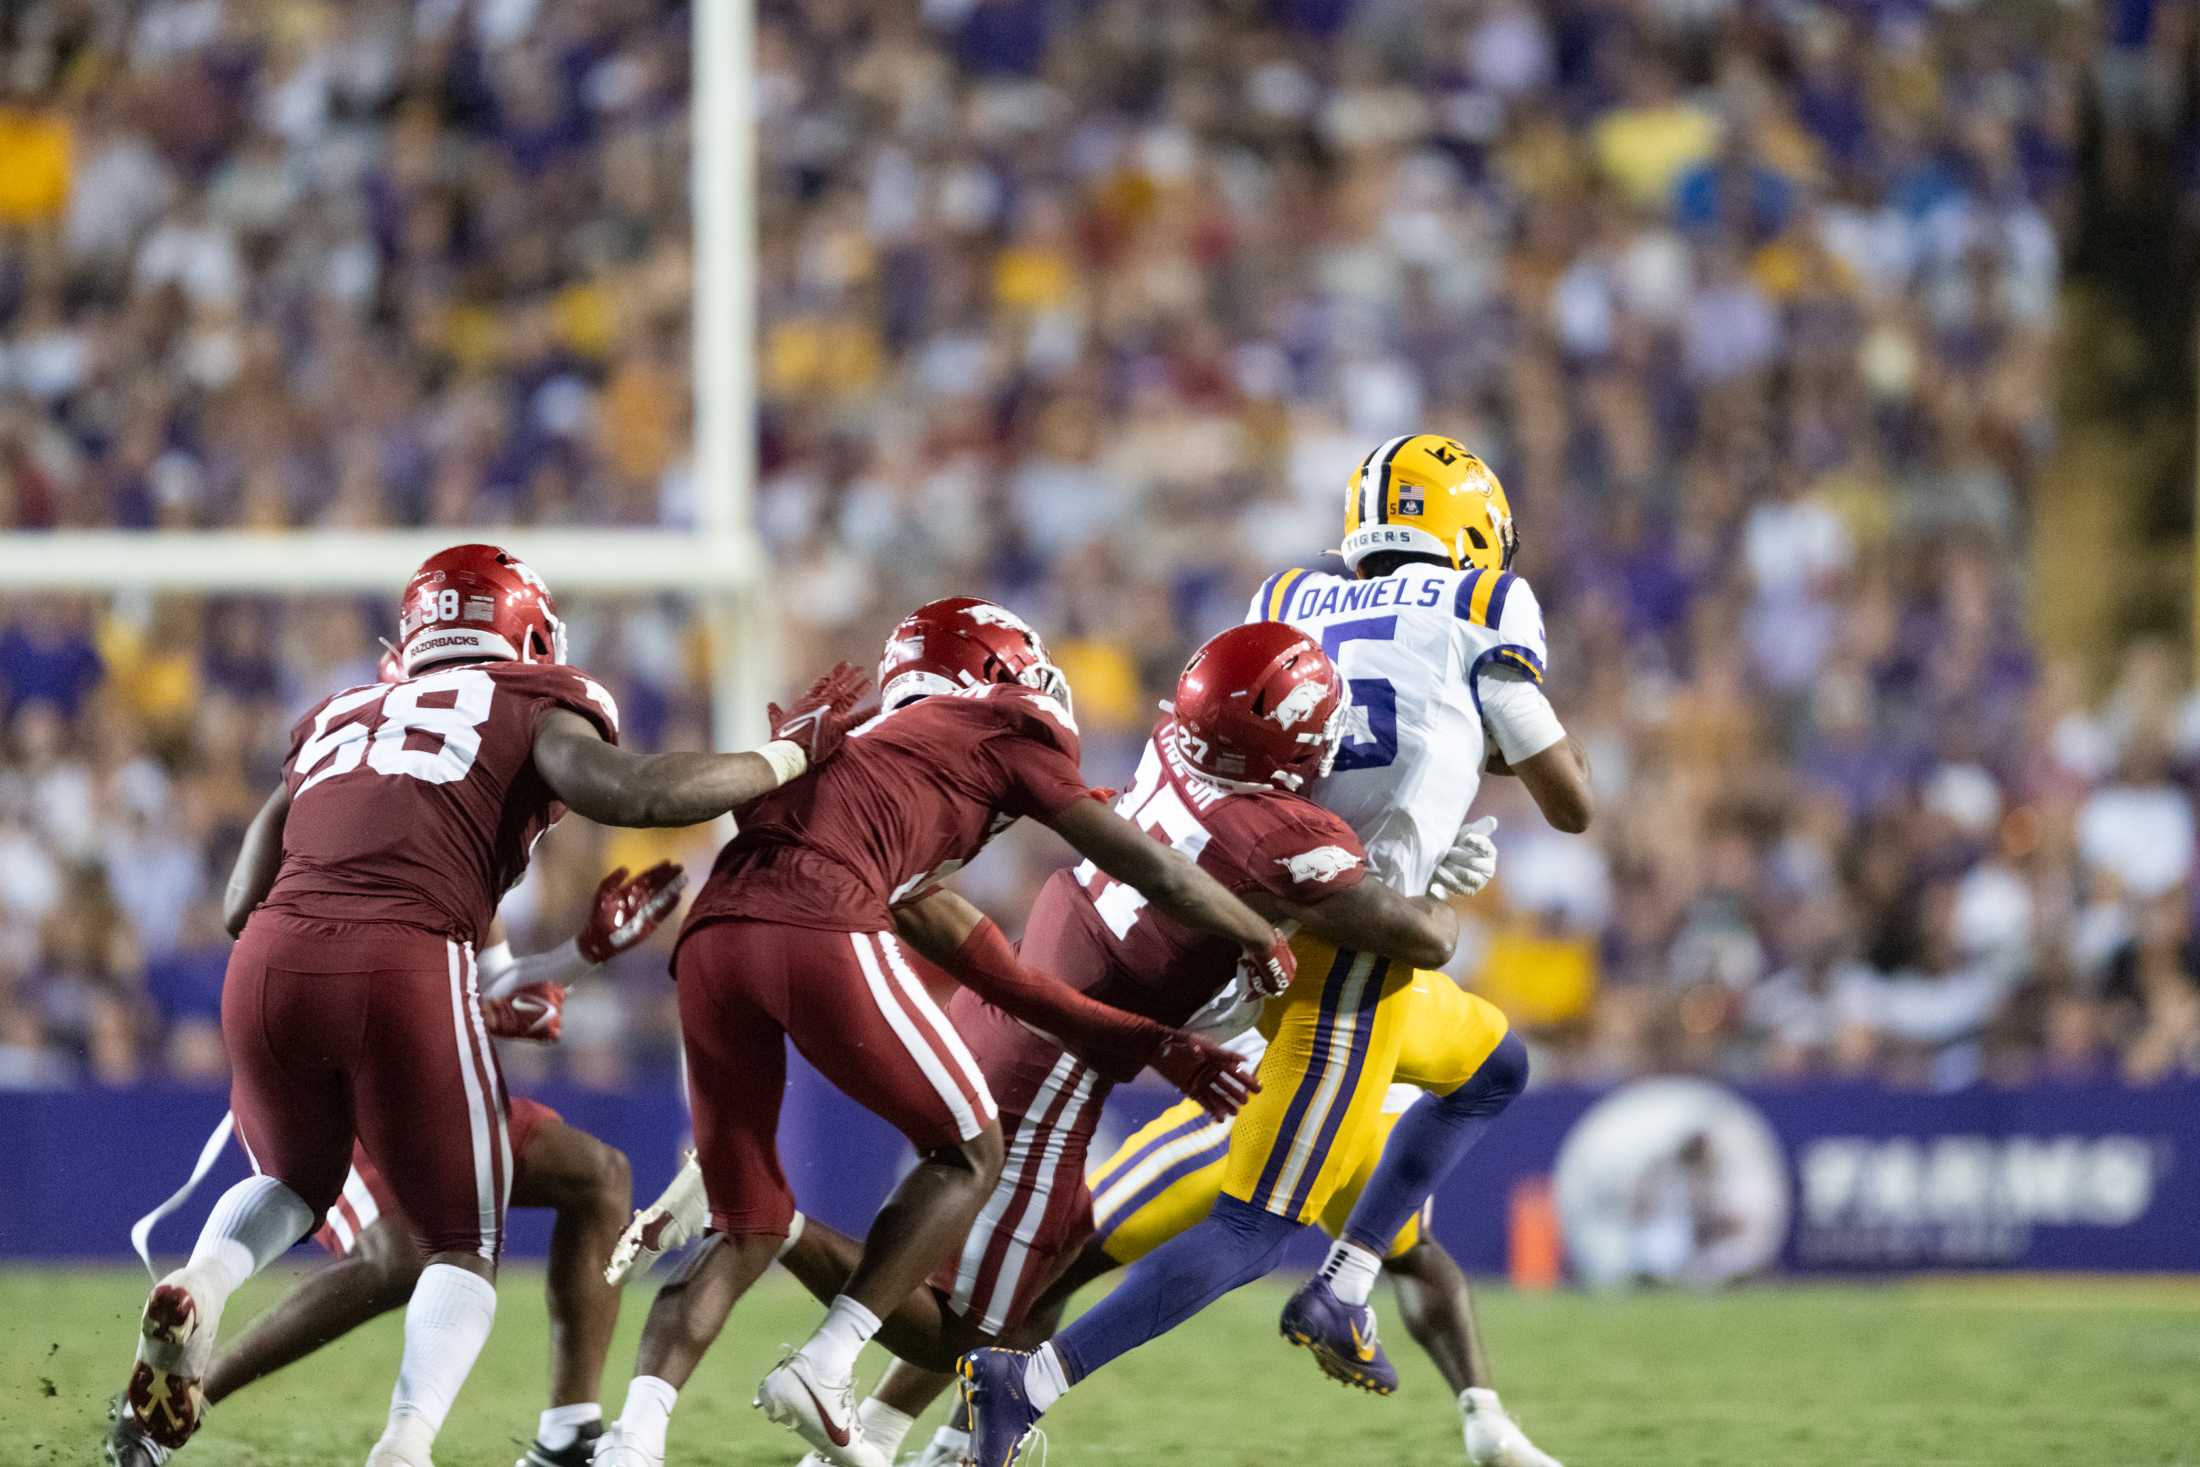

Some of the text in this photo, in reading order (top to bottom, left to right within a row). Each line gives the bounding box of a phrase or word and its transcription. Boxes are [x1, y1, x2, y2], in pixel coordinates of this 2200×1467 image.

[1347, 531, 1411, 550] TIGERS
[420, 588, 460, 625] 58
[1297, 577, 1445, 620] DANIELS
[410, 636, 480, 656] RAZORBACKS
[1321, 615, 1399, 771] 5
[294, 669, 496, 799] 58
[1178, 725, 1209, 765] 27
